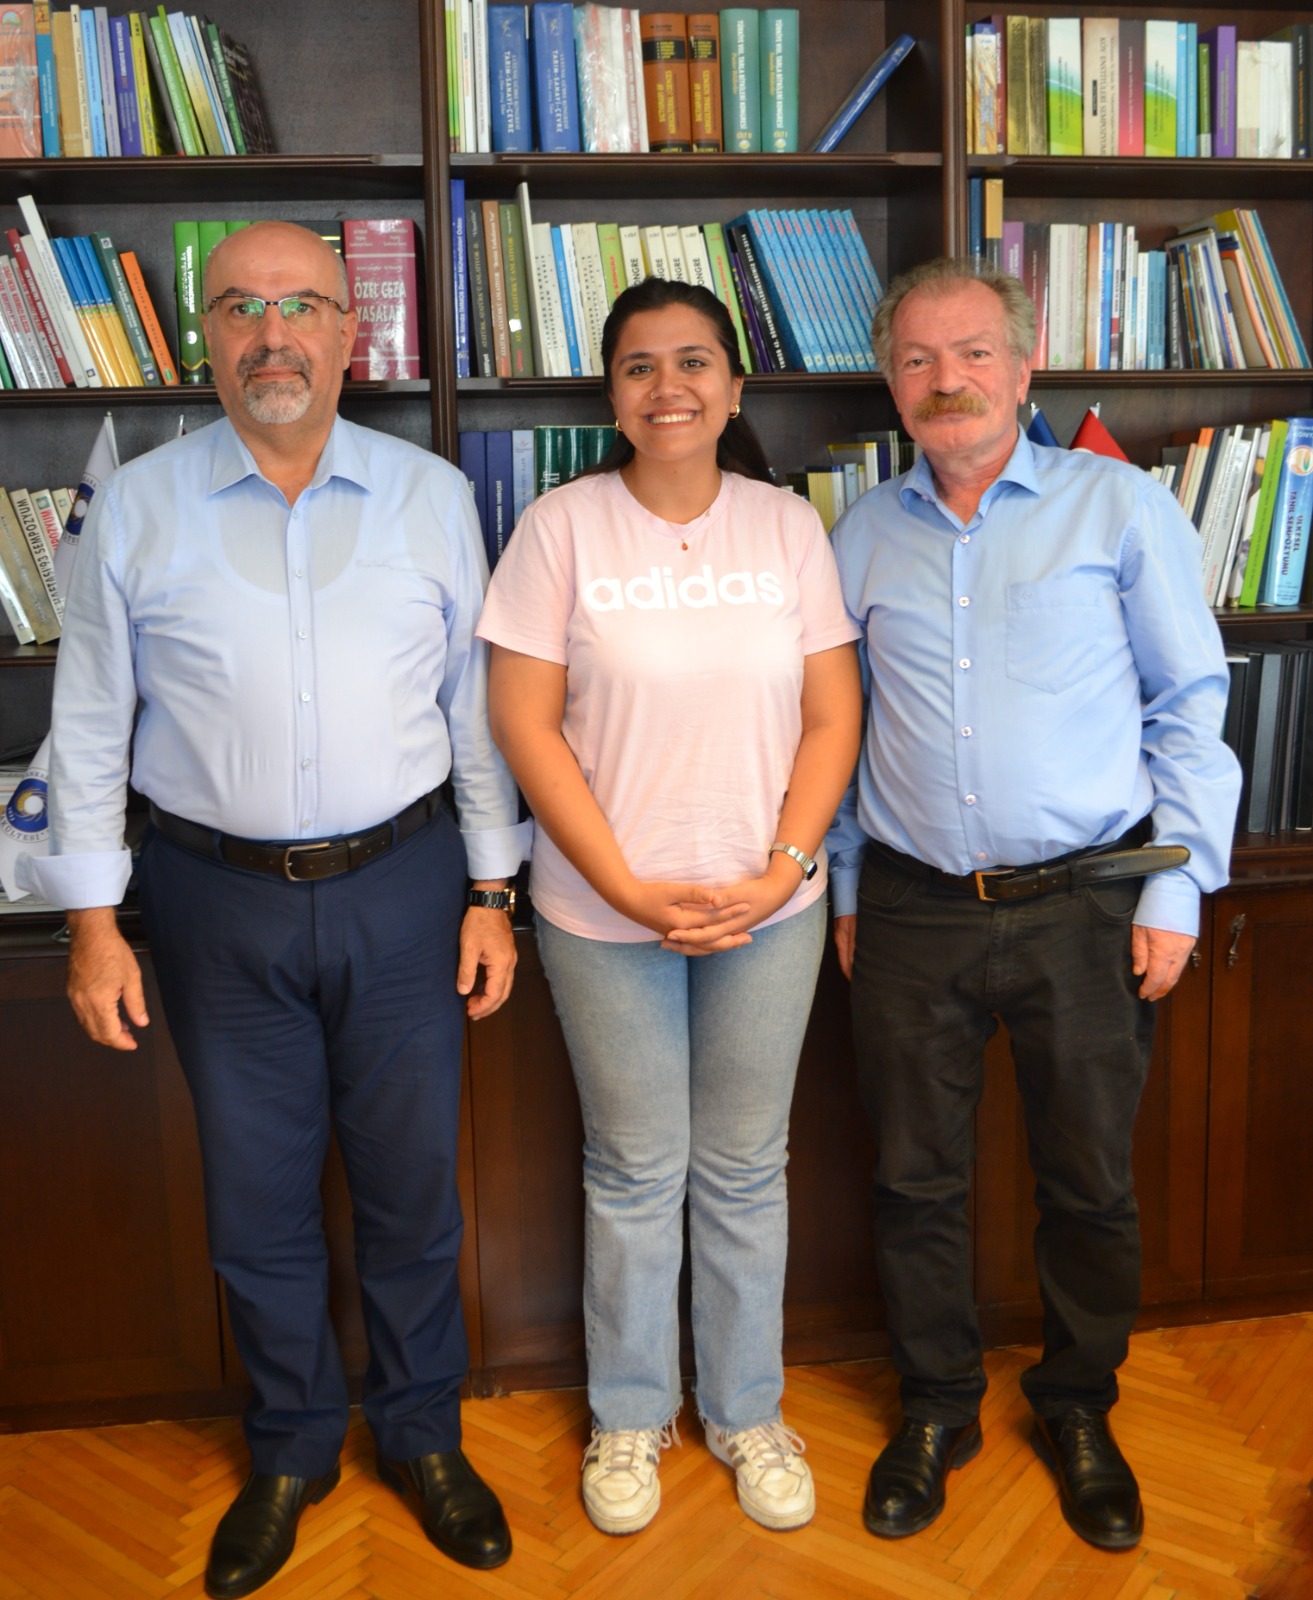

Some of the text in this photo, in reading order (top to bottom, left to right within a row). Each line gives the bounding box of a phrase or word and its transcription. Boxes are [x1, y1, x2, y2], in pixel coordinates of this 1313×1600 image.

[116, 22, 124, 51] DÜNYANIN
[737, 20, 745, 42] TÜRKİYE
[775, 19, 784, 42] TÜRKİYE
[118, 53, 127, 76] DURUMU
[213, 41, 225, 63] organik
[222, 80, 232, 97] tarım
[504, 51, 515, 134] TARIM-SANAYİ-ÇEVRE
[552, 50, 563, 133] TARIM-SANAYİ-ÇEVRE
[739, 75, 747, 100] BİTKİLERİ
[776, 74, 784, 100] BİTKİLERİ
[739, 102, 747, 129] KONGRESİ
[776, 101, 784, 128] KONGRESİ
[506, 237, 515, 273] ANLATIYOR
[740, 233, 753, 262] 2012-2014
[111, 259, 120, 276] TARIM
[116, 277, 129, 302] İLAÇLARI
[631, 258, 641, 285] ONGRE
[656, 258, 665, 278] NGRE
[673, 258, 683, 279] NGRE
[693, 258, 704, 285] ONGRE
[354, 277, 379, 299] ÖZEL
[535, 267, 545, 300] TEKNİK
[582, 267, 590, 300] TEKNİK
[749, 262, 769, 311] SÖYLEDİKLERİMİZ
[764, 311, 777, 338] DÖNEMDE
[17, 499, 46, 553] SEMPOZYUM
[41, 510, 59, 550] MPOZYUM
[1293, 515, 1304, 552] ÜLKESEL
[1281, 516, 1293, 576] SEMPOZYUMU
[585, 564, 785, 613] adidas
[0, 814, 40, 842] AKÜLTESİ
